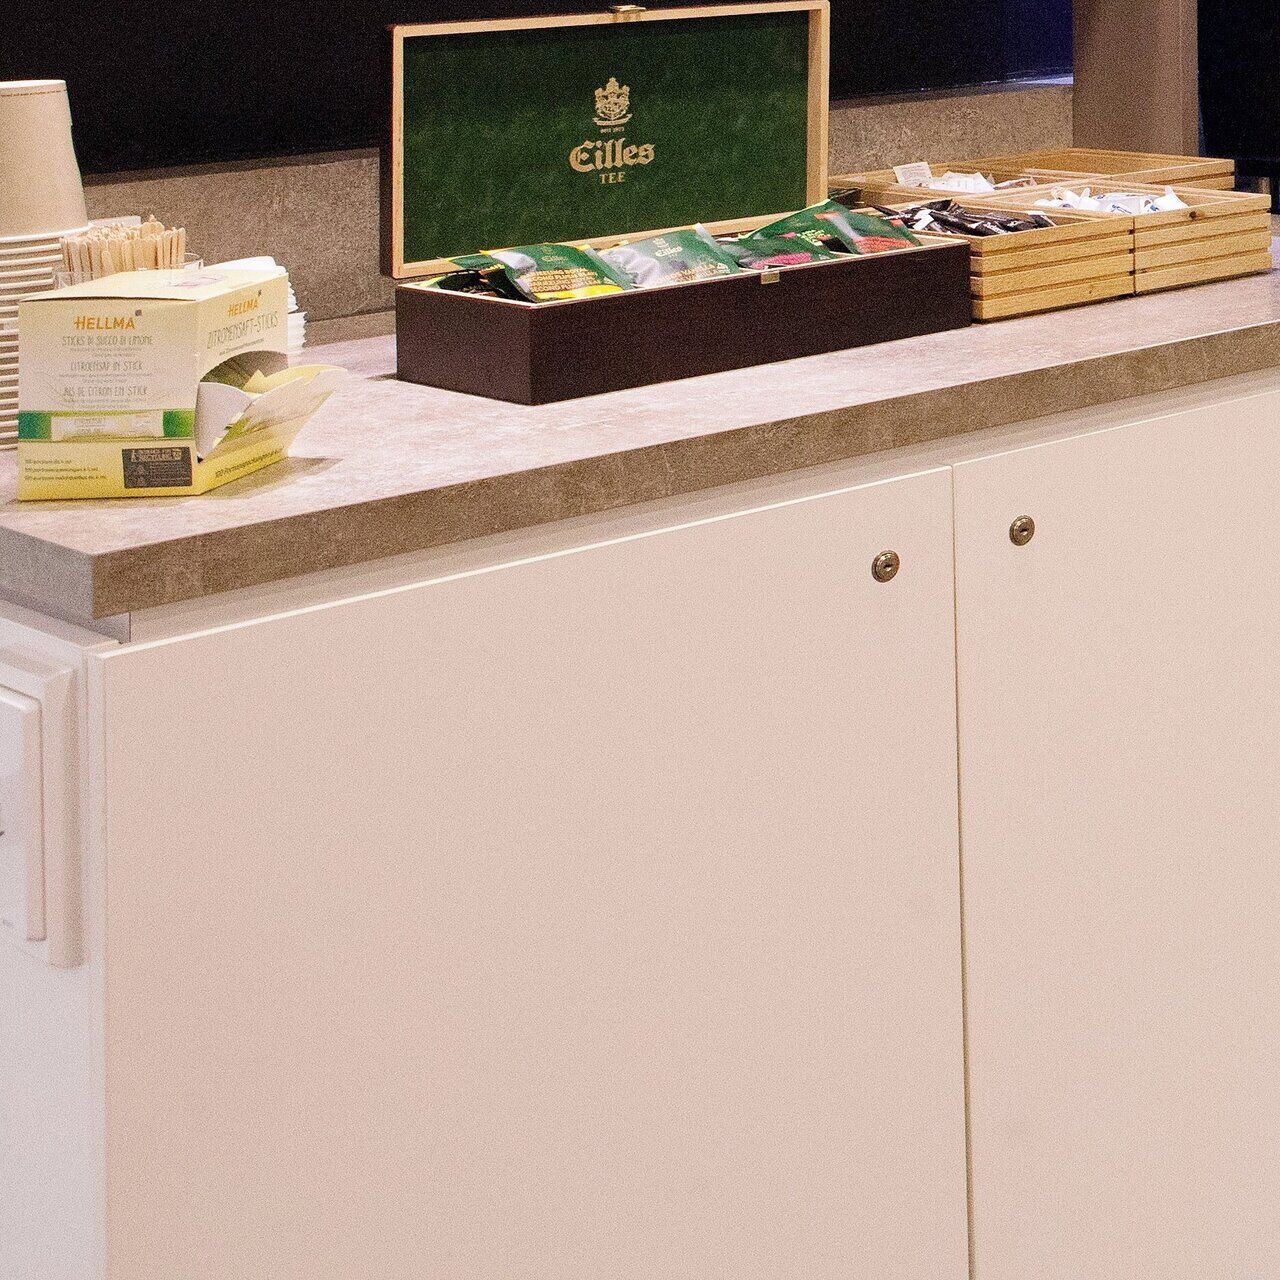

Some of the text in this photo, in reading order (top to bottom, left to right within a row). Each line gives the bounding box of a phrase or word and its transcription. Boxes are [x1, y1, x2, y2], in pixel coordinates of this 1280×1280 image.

[569, 138, 655, 172] Eilles
[600, 172, 625, 184] TEE
[227, 299, 258, 317] HELLMA
[73, 316, 135, 330] HELLMA
